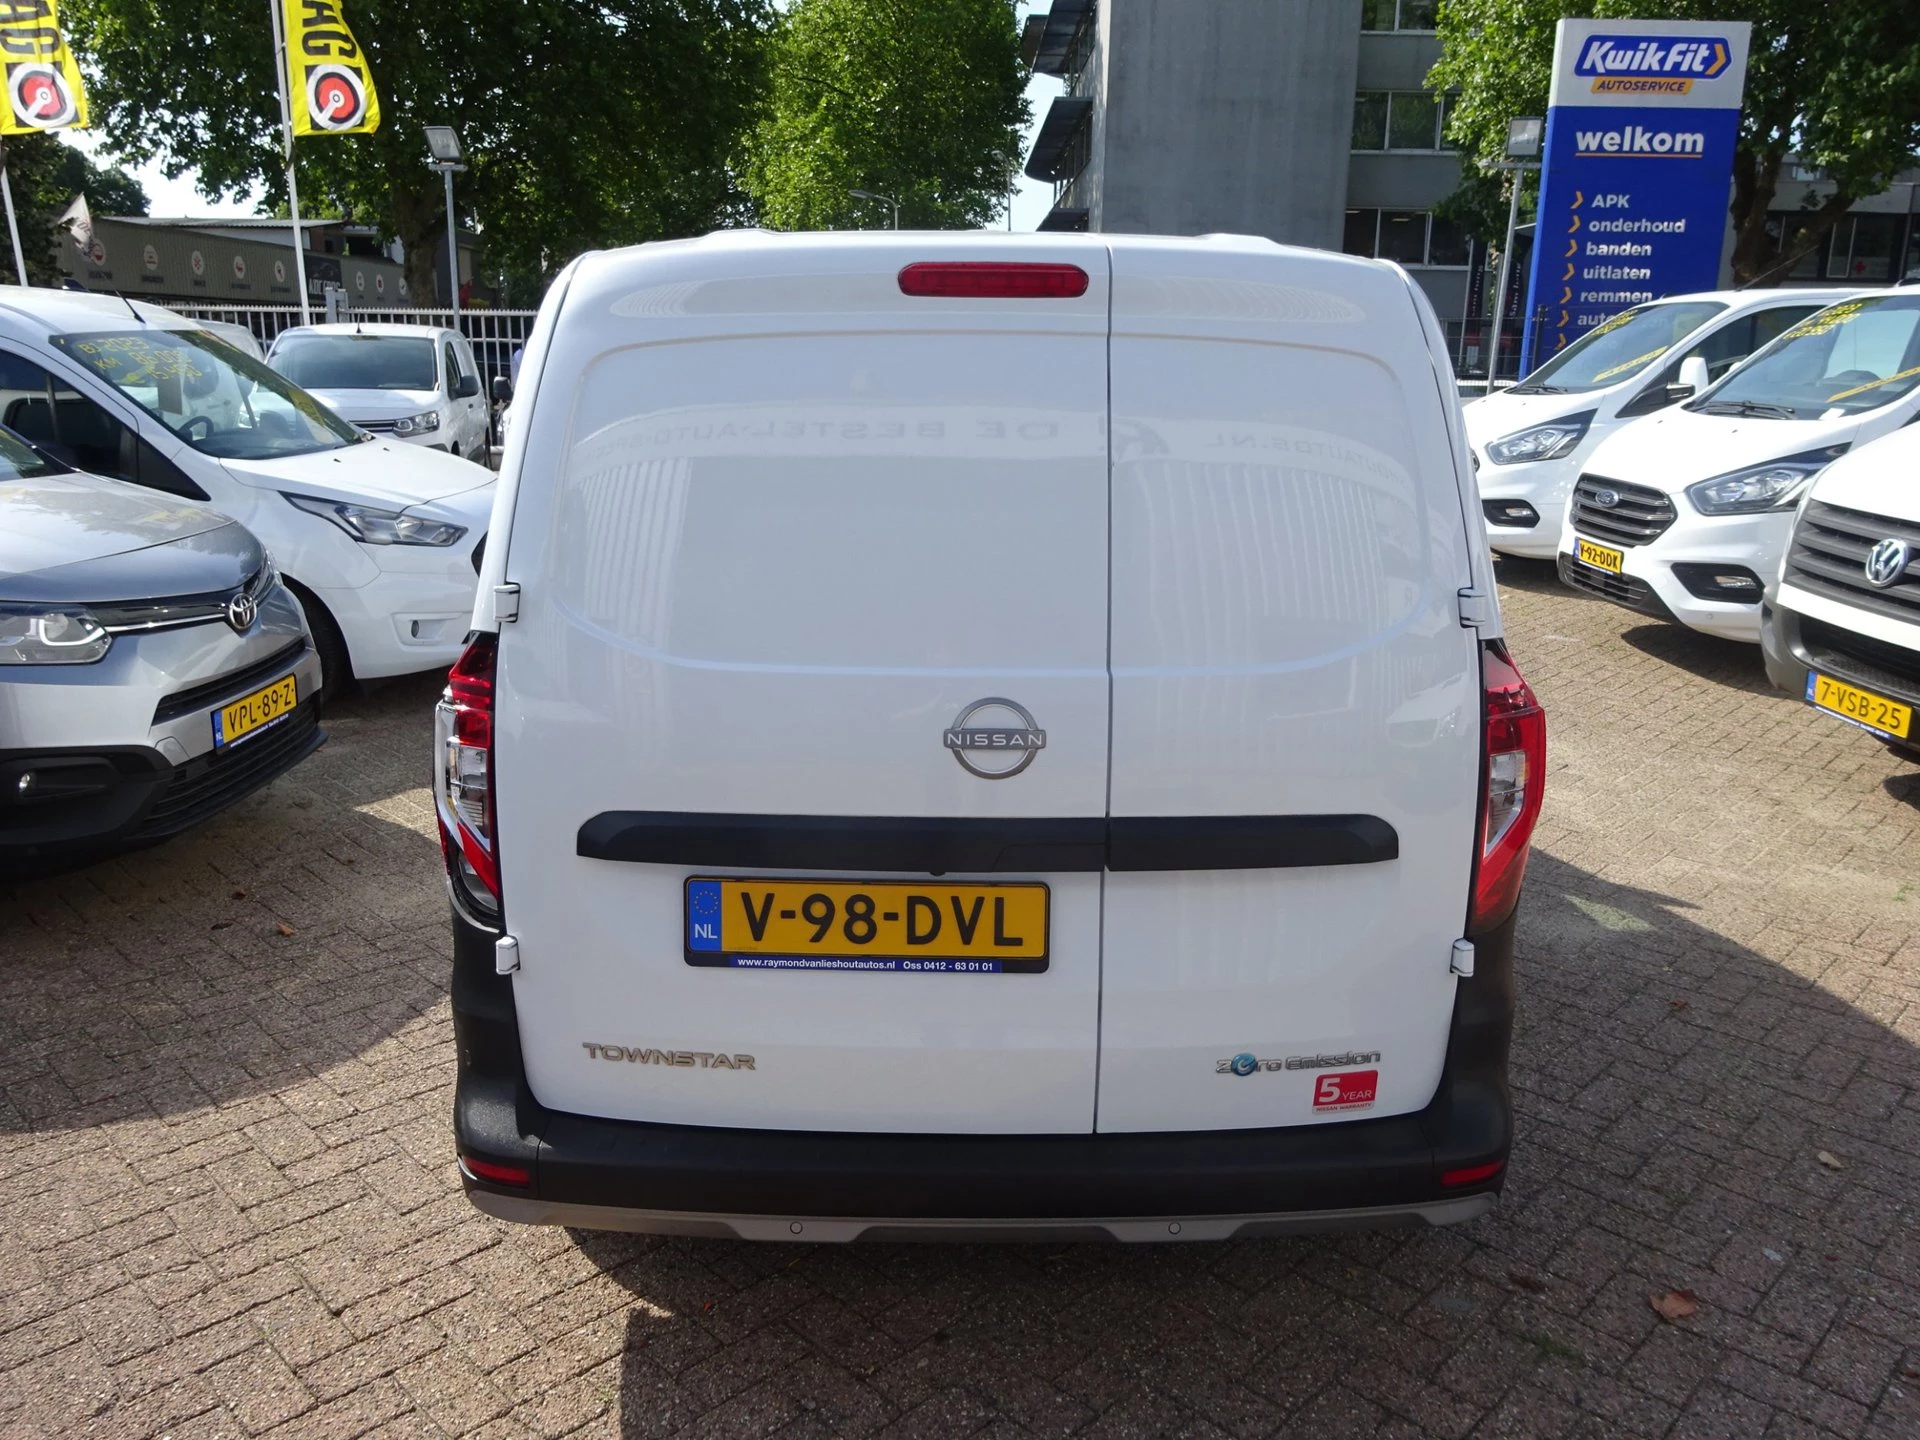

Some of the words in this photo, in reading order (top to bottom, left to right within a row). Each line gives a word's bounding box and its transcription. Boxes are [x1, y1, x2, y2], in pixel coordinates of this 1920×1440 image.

[1597, 80, 1686, 92] AUTOSERVICE
[1575, 126, 1705, 152] welkom
[1591, 194, 1630, 208] APK
[1588, 218, 1686, 233] onderhoud
[1586, 241, 1652, 256] banden
[1583, 265, 1651, 280] uitlaten
[1580, 291, 1653, 303] remmen
[228, 683, 292, 733] VPL-89-Z
[1821, 681, 1901, 730] 7-VSB-25
[947, 733, 1042, 746] NISSAN
[740, 891, 1024, 947] V-98-DVL
[694, 923, 718, 939] NL
[737, 957, 896, 970] www.raymondvanlieshoutautos.nl
[903, 961, 922, 971] Oss
[923, 961, 947, 971] 0412
[954, 961, 967, 971] 63
[968, 962, 980, 971] 01
[982, 962, 993, 971] 01
[582, 1042, 756, 1071] TOWNSTAR
[1318, 1077, 1341, 1103] 5
[1342, 1089, 1372, 1101] YEAR
